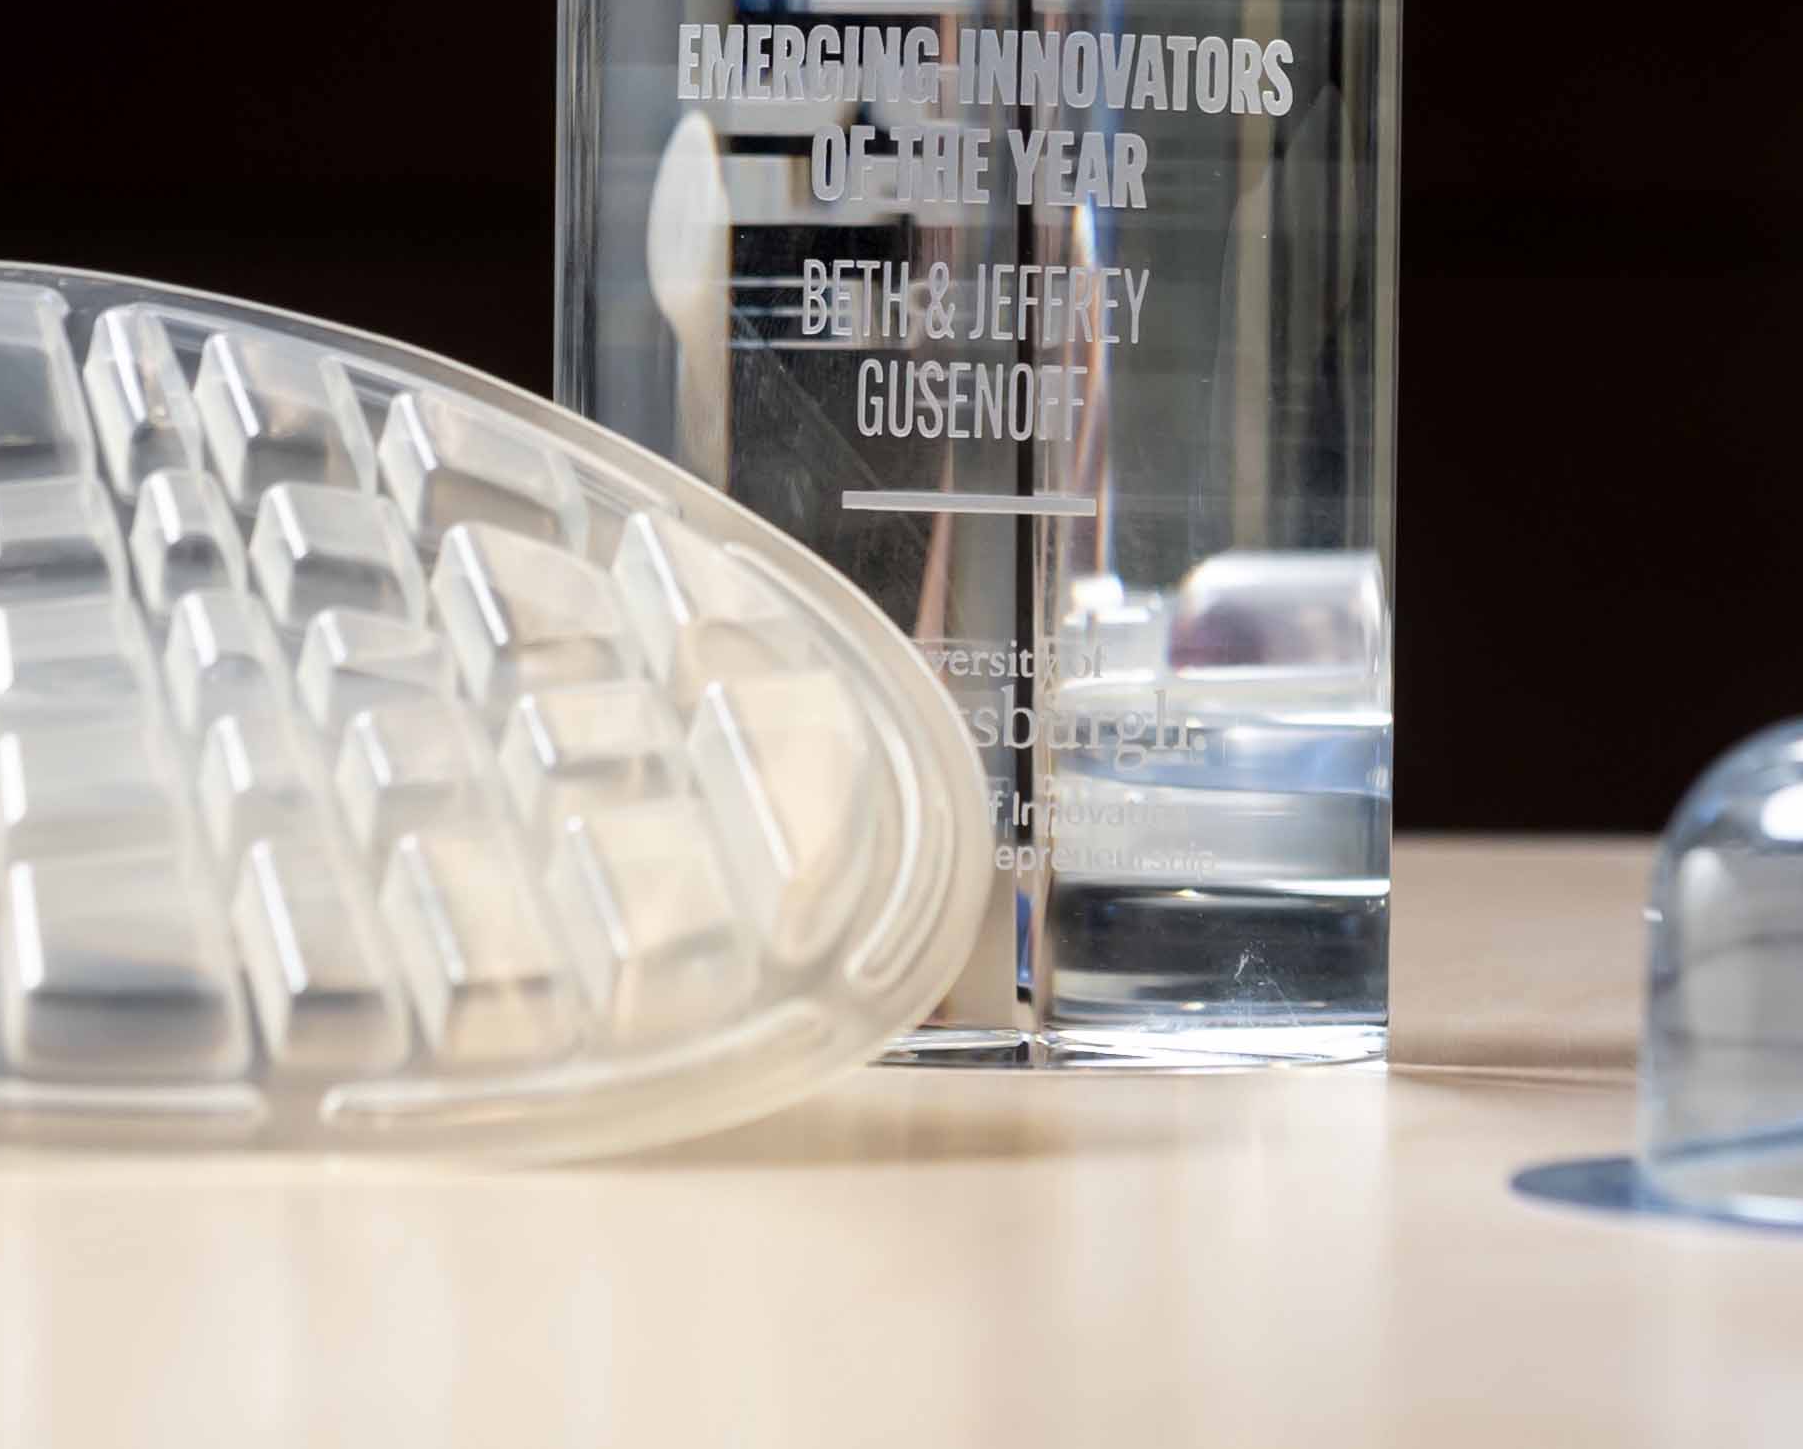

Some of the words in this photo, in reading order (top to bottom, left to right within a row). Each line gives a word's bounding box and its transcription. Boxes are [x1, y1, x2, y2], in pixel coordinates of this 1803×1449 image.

[677, 23, 940, 104] EMERGING
[959, 28, 1294, 117] INNOVATORS
[811, 125, 875, 202] OF
[891, 126, 990, 204] THE
[1008, 129, 1148, 209] YEAR
[801, 258, 909, 338] BETH
[927, 261, 955, 340] &
[968, 262, 1150, 344] JEFFREY
[856, 358, 1089, 443] GUSENOFF
